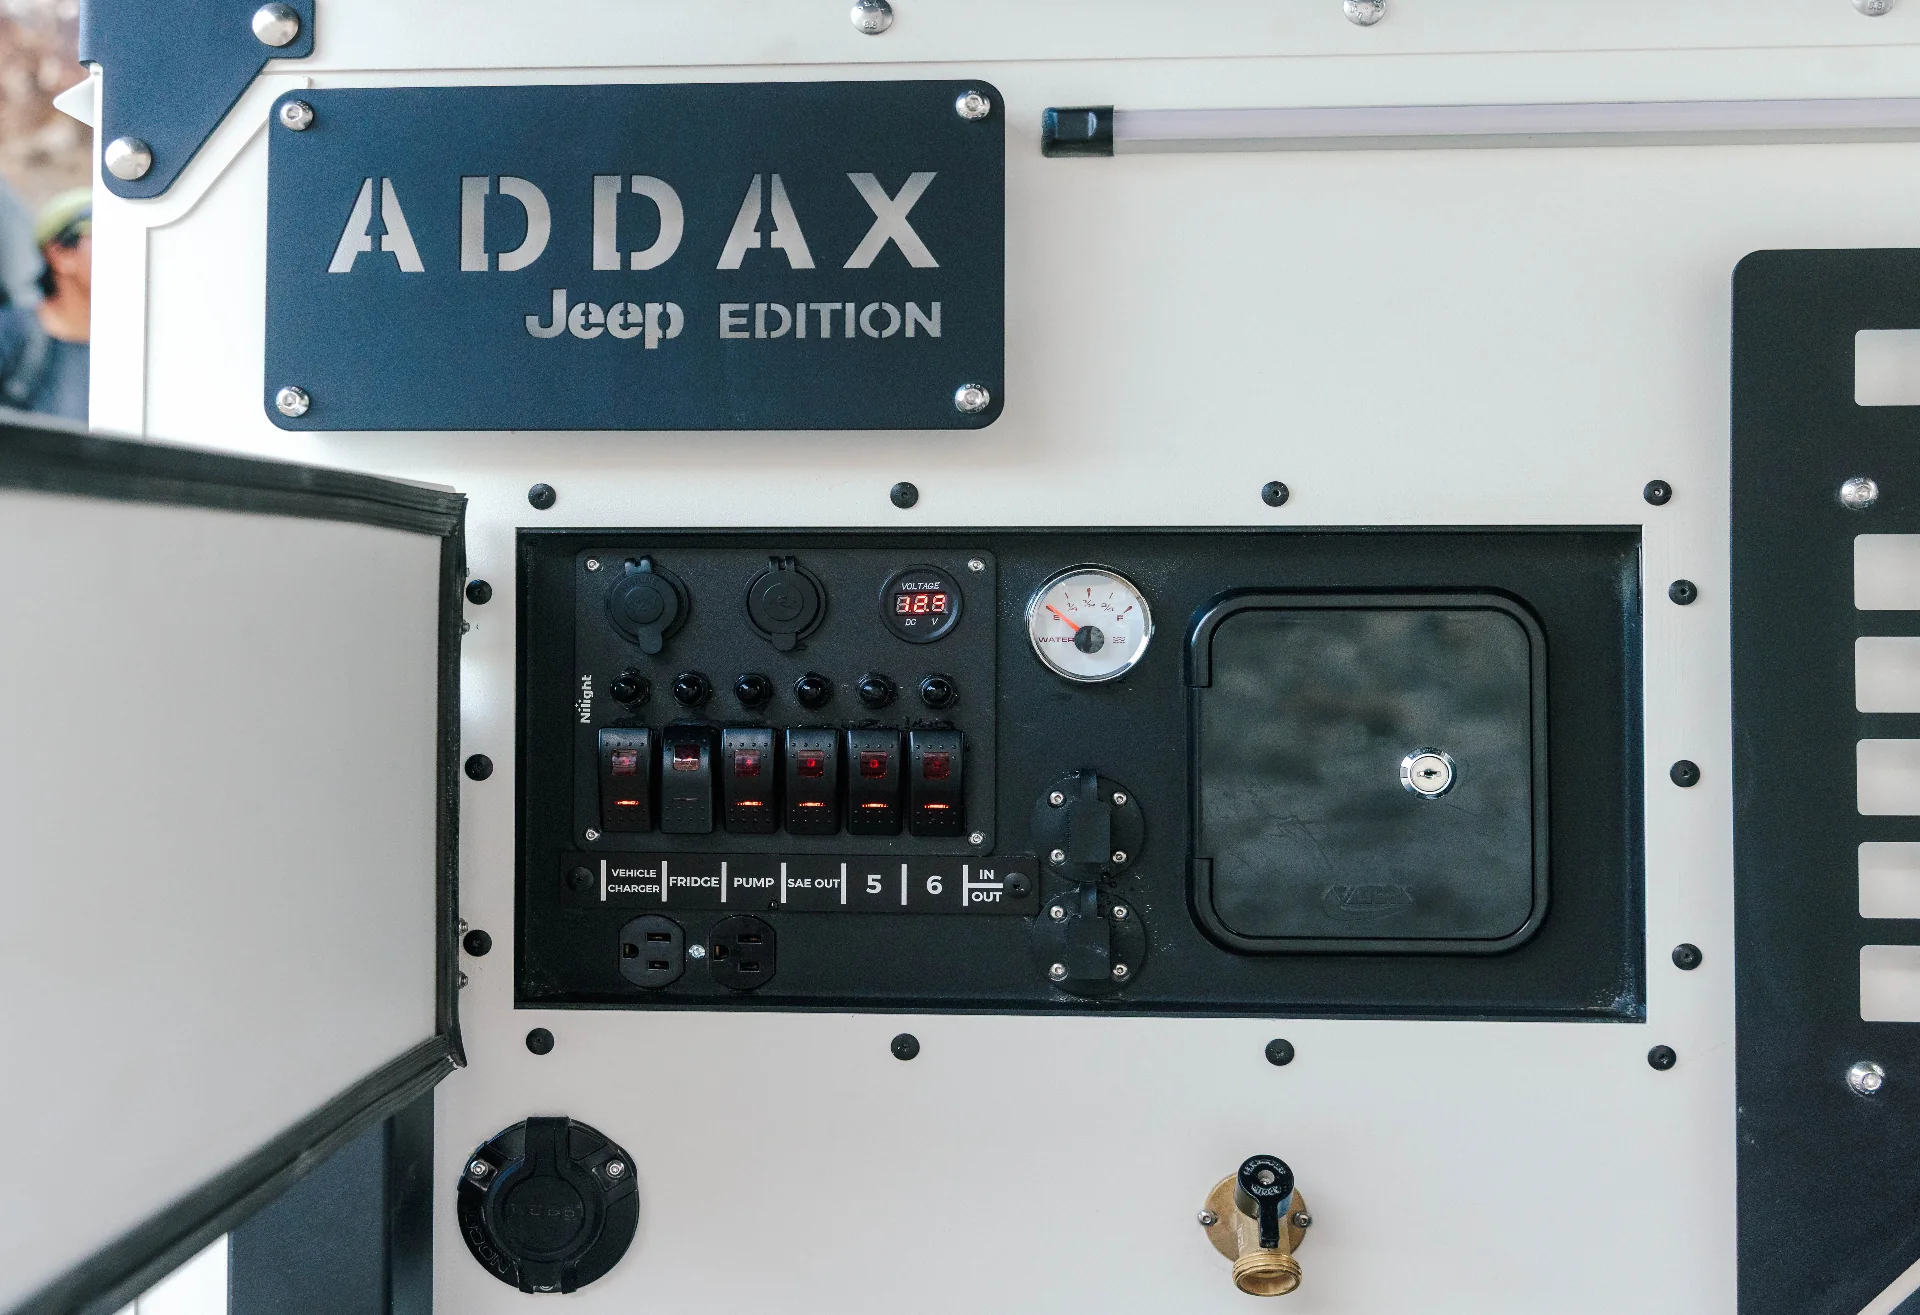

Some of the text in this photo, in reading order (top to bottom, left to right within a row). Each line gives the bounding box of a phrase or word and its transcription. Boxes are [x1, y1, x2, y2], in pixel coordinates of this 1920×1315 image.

[327, 171, 941, 274] ADDAX
[525, 288, 942, 350] Jeep EDITION
[901, 581, 941, 591] VOLTAGE
[905, 617, 939, 626] DC V
[1116, 614, 1124, 622] F
[574, 674, 594, 724] Nilight
[611, 868, 657, 878] VEHICLE
[979, 869, 995, 880] IN
[669, 876, 720, 888] FRIDGE
[733, 877, 775, 888] PUMP
[787, 878, 841, 889] SAE OUT
[865, 874, 882, 894] 5
[926, 875, 943, 895] 6
[607, 884, 660, 893] CHARGER
[971, 891, 1003, 902] OUT
